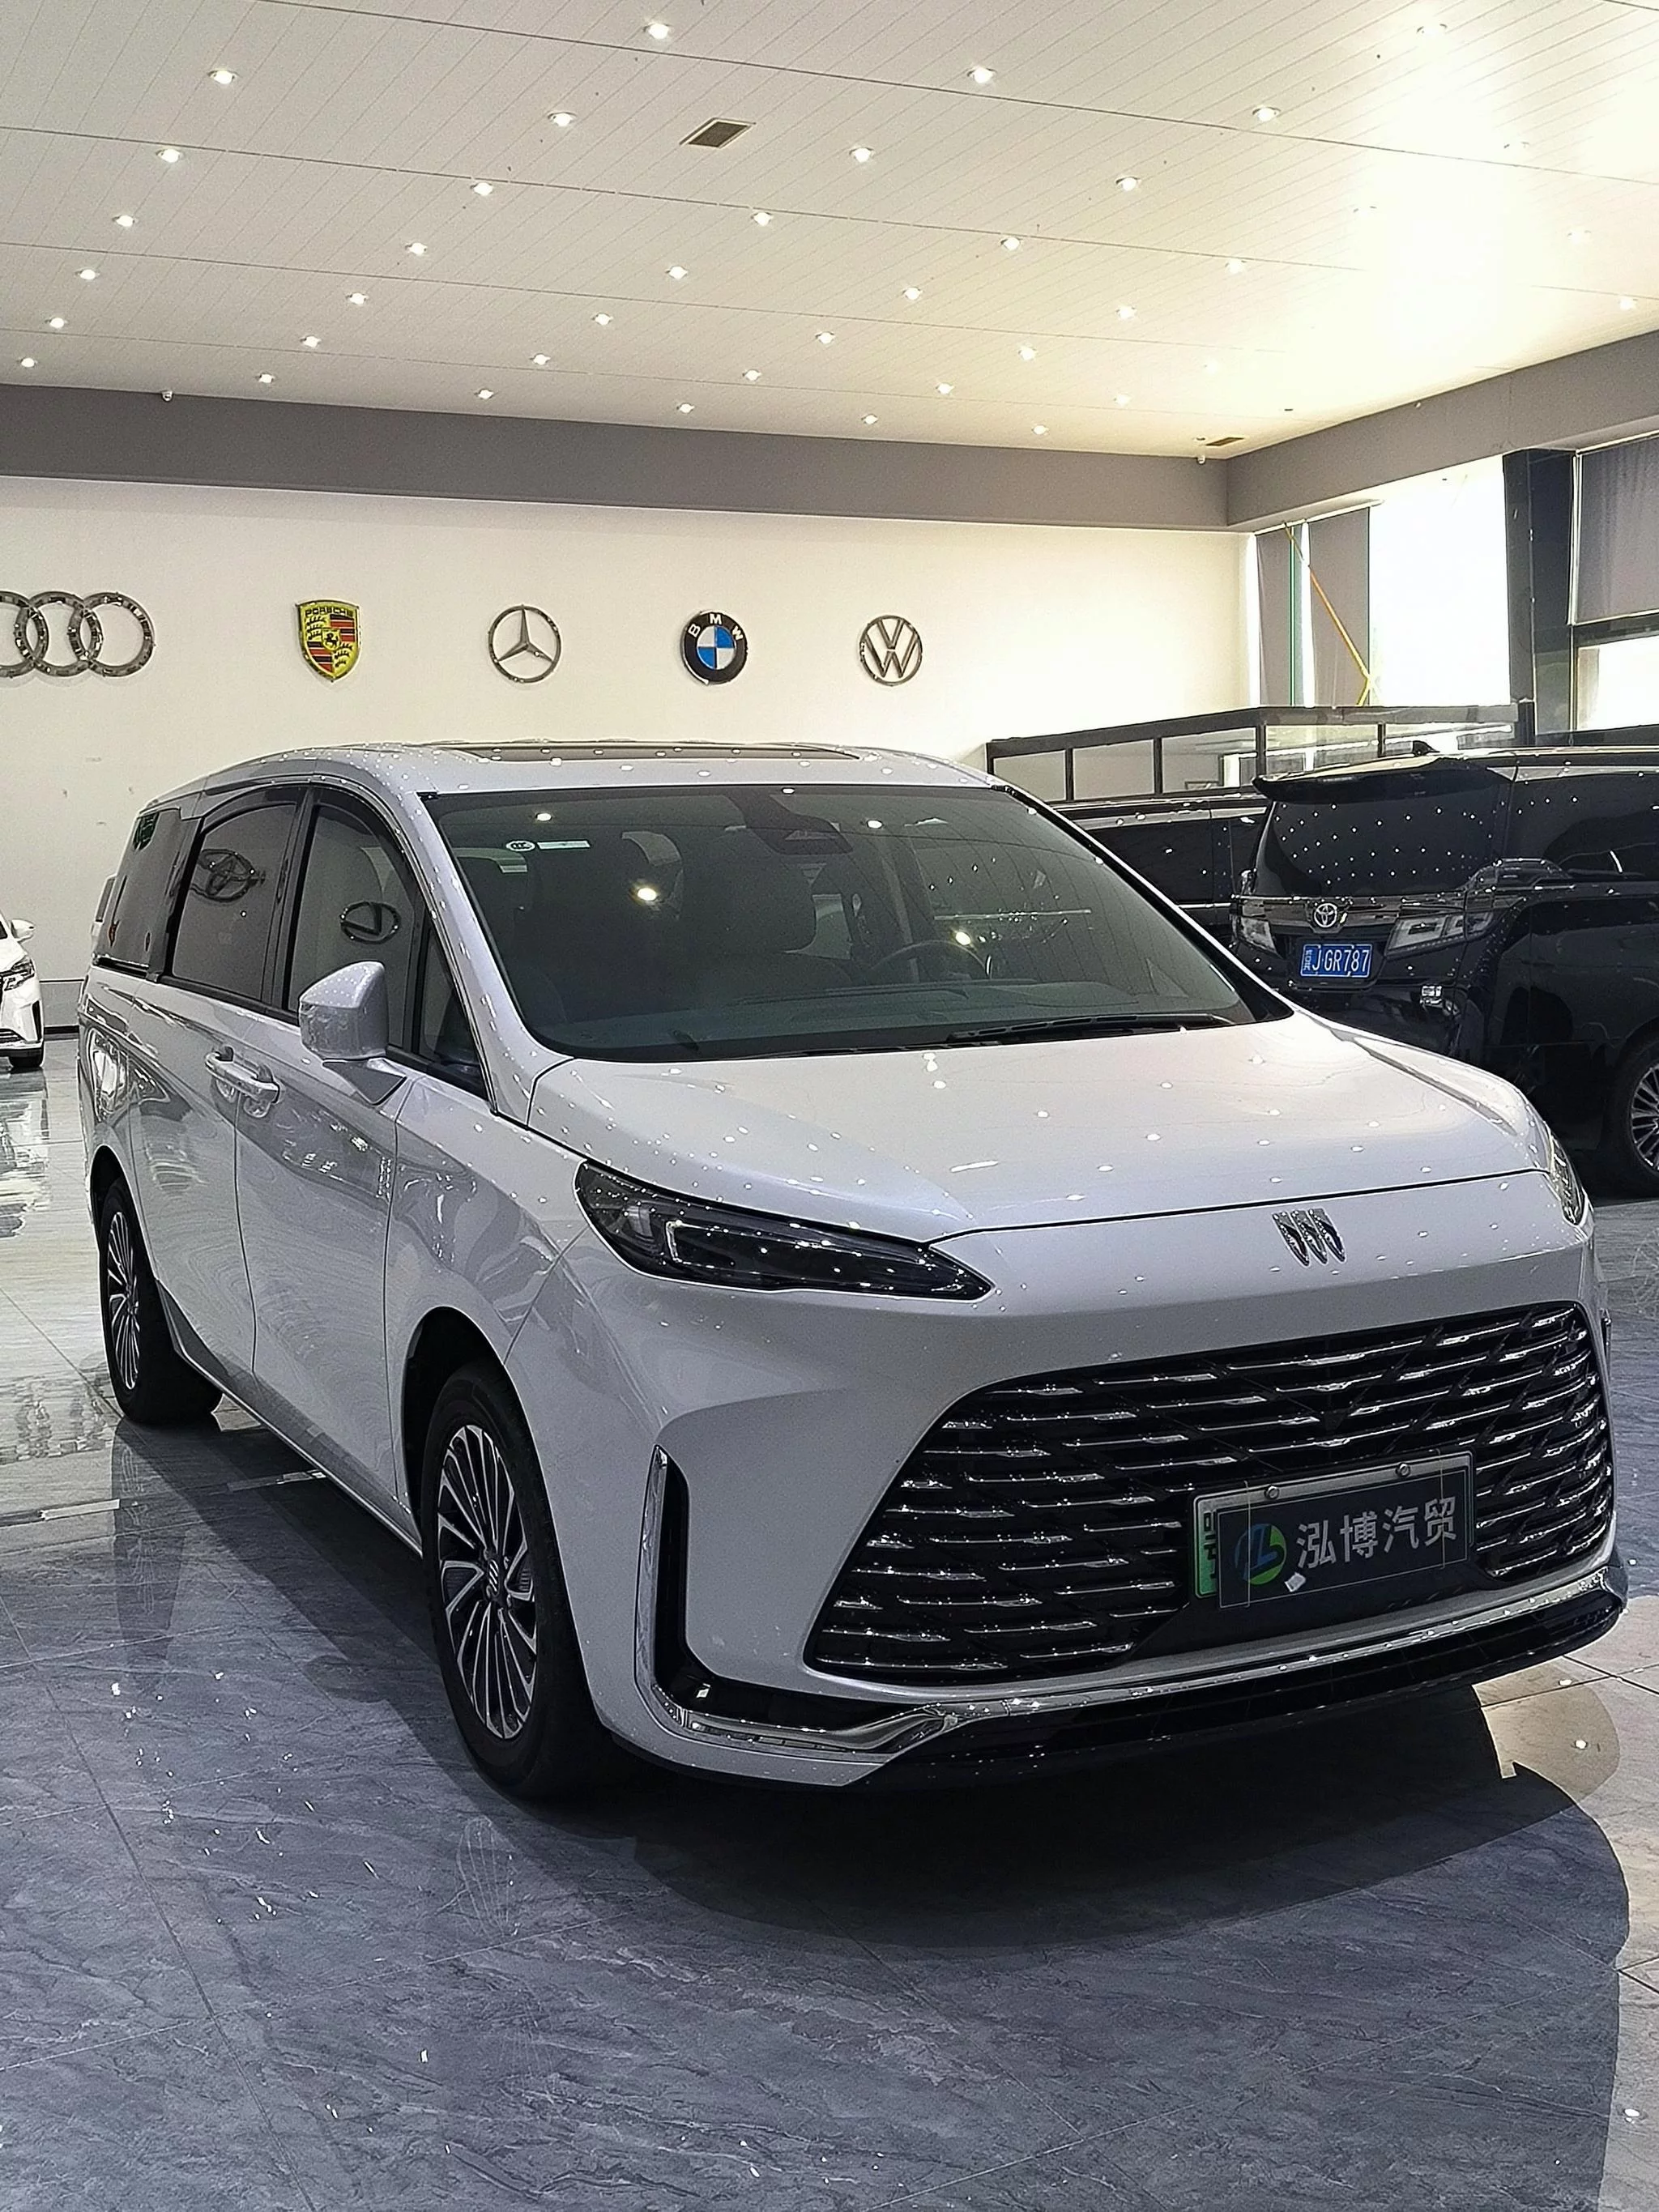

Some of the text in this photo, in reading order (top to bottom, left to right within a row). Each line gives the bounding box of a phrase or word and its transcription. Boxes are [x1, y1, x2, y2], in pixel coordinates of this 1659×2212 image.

[305, 606, 354, 617] PORSCHE
[688, 613, 744, 641] BMW
[1296, 1497, 1457, 1570] 泓博汽贸
